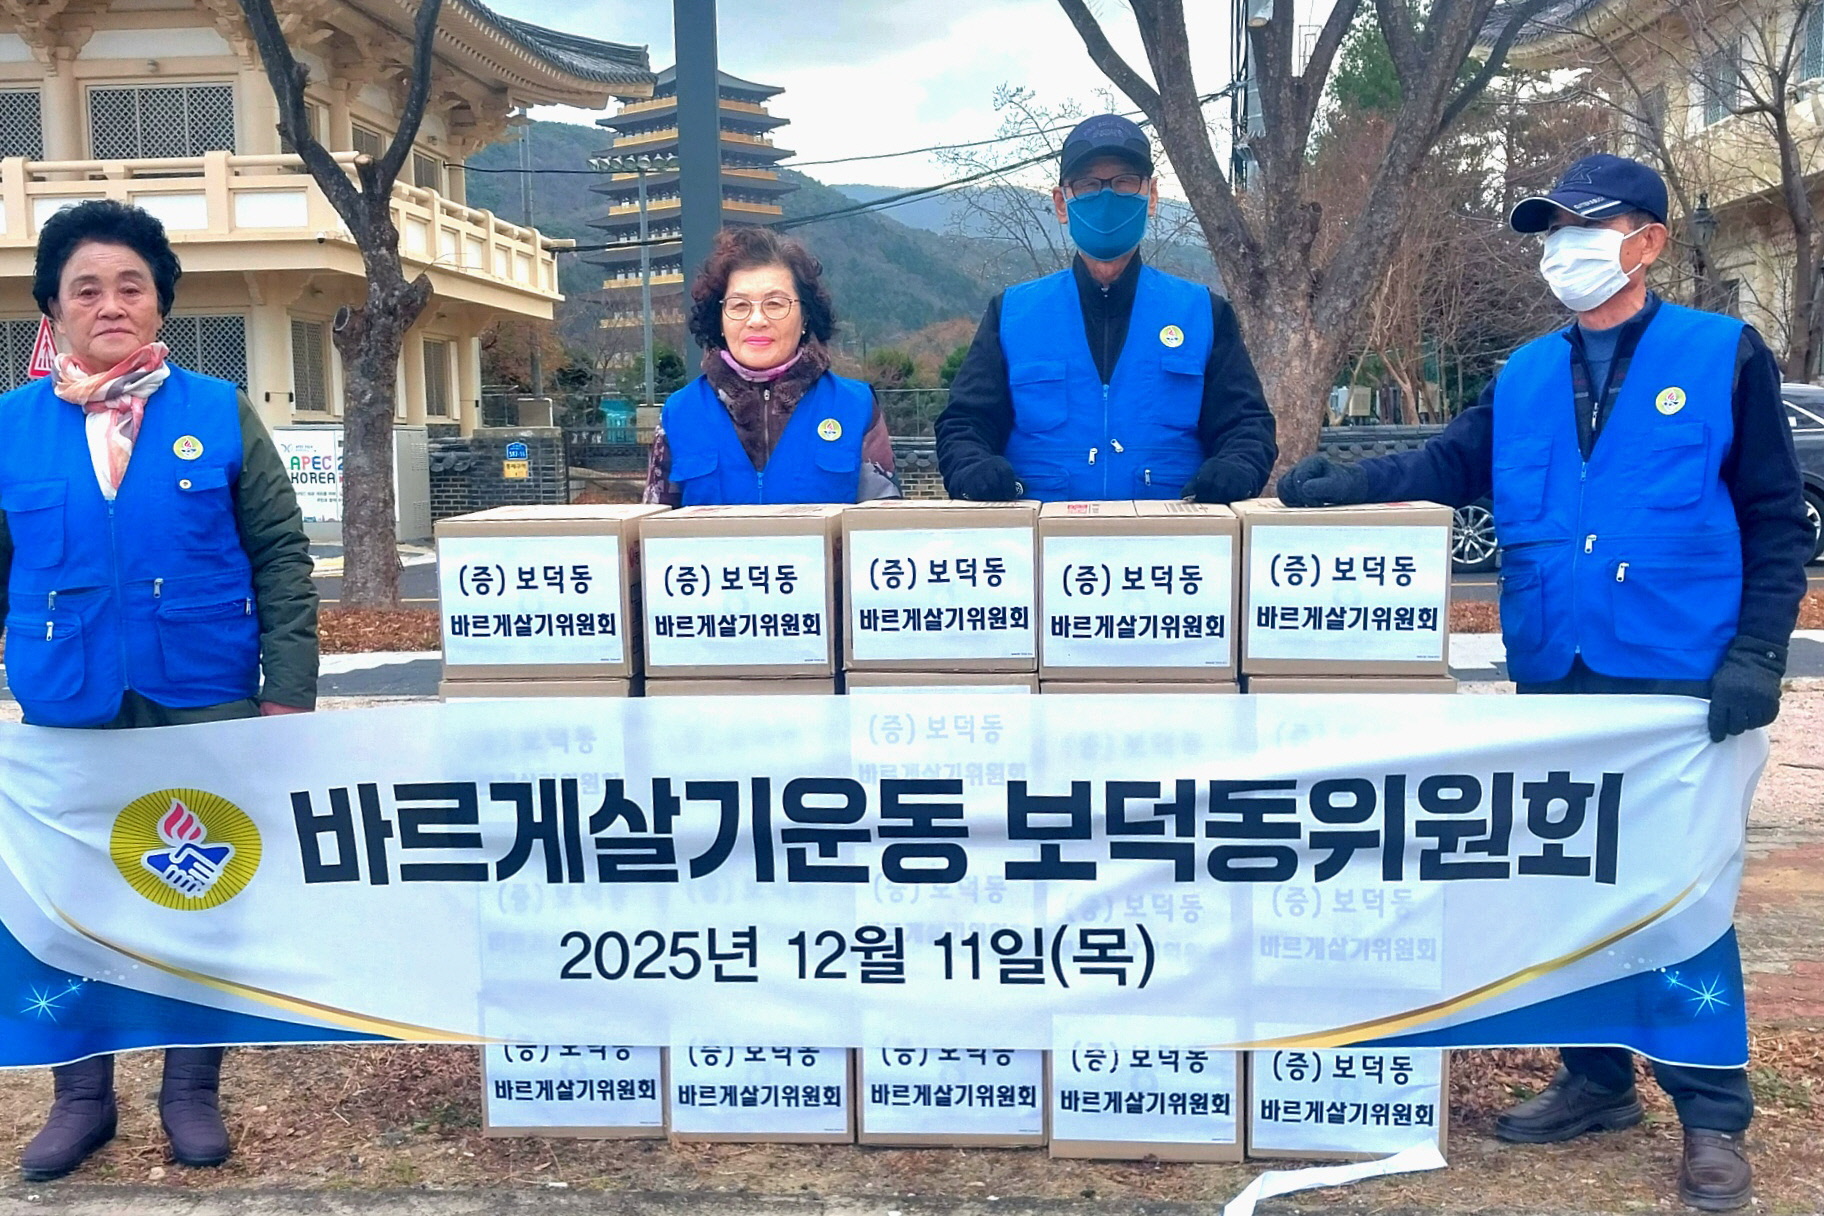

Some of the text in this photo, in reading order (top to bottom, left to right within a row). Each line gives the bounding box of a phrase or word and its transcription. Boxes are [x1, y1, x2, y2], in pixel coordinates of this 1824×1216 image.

[290, 456, 332, 470] APEC
[290, 472, 336, 484] KOREA
[460, 565, 592, 596] (증) 보덕동
[665, 565, 797, 596] (증) 보덕동
[871, 558, 1005, 590] (증) 보덕동
[1064, 564, 1202, 596] (증) 보덕동
[1271, 554, 1416, 587] (증) 보덕동
[451, 613, 615, 637] 바르게살기위원회
[655, 613, 821, 637] 바르게살기위원회
[860, 607, 1028, 631] 바르게살기위원회
[1052, 615, 1224, 638] 바르게살기위원회
[1257, 606, 1437, 631] 바르게살기위원회
[290, 771, 1624, 885] 바르게살기운동 보덕동위원회
[561, 926, 758, 982] 2025년
[789, 926, 905, 983] 12월
[934, 924, 1154, 988] 11일(목)
[1274, 1051, 1413, 1085] (증) 보덕동
[495, 1079, 656, 1101] 바르게살기위원회
[679, 1085, 840, 1107] 바르게살기위원회
[872, 1084, 1036, 1108] 바르게살기위원회
[1061, 1090, 1229, 1115] 바르게살기위원회
[1261, 1099, 1433, 1126] 바르게살기위원회
